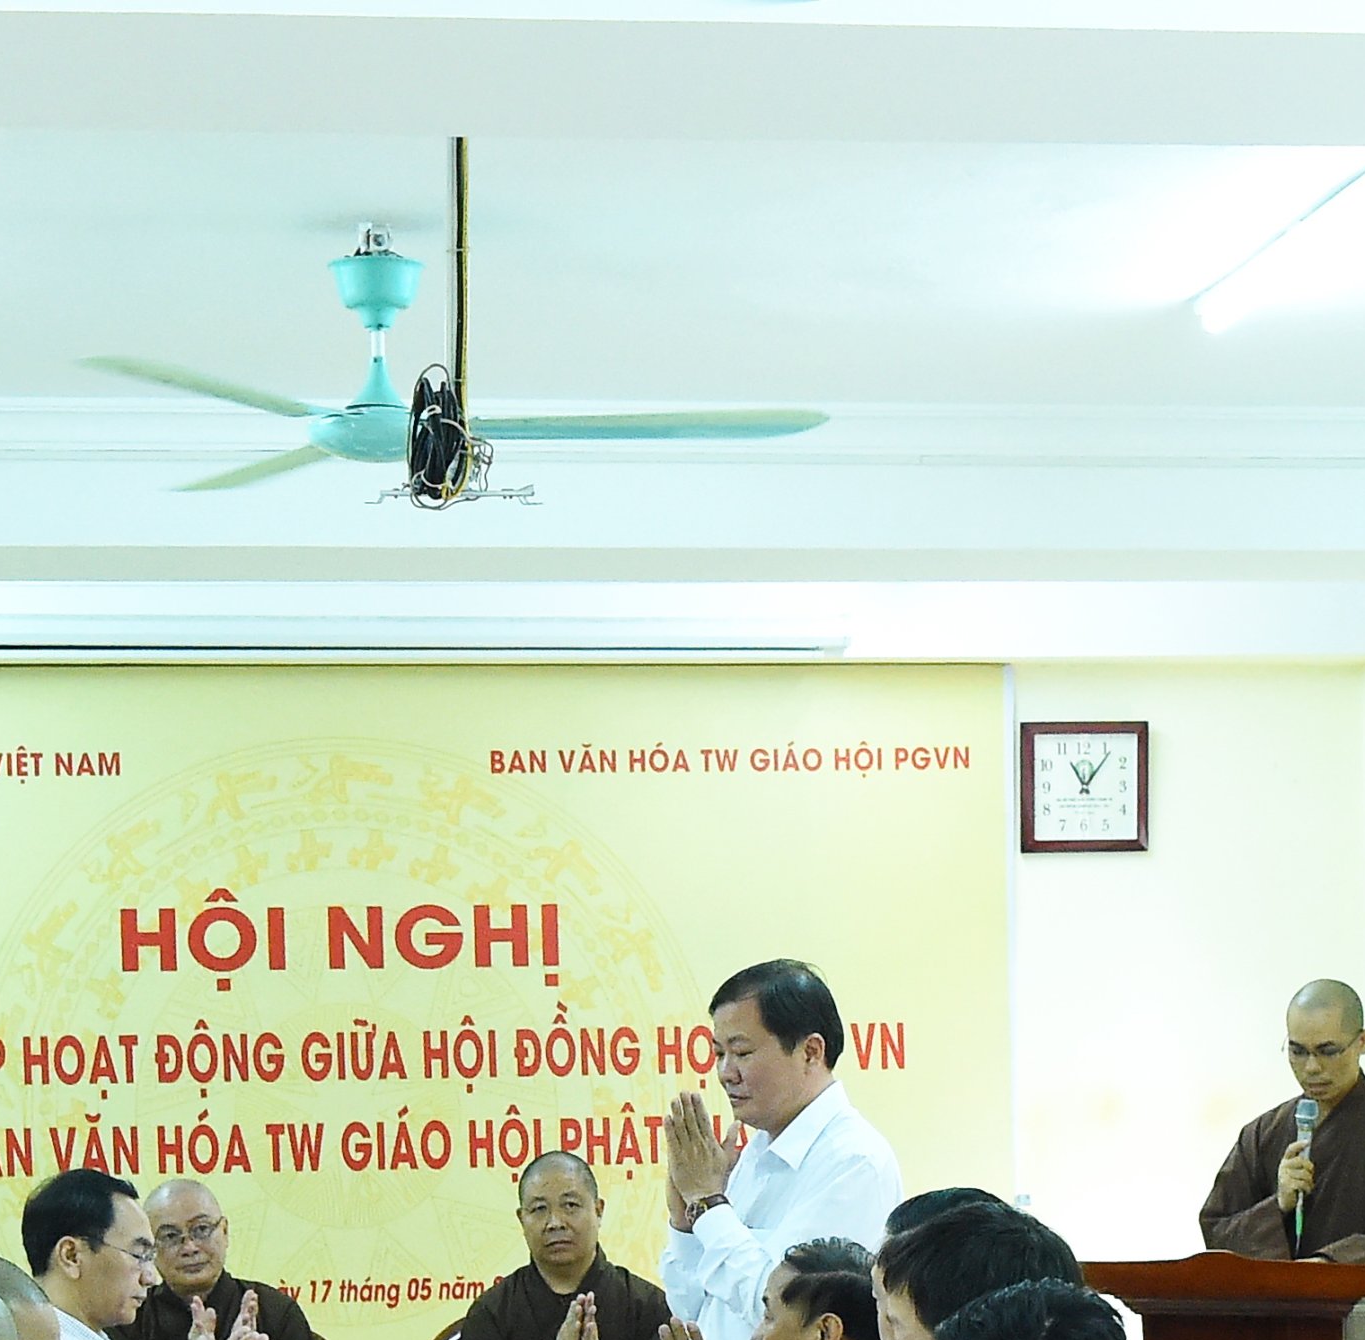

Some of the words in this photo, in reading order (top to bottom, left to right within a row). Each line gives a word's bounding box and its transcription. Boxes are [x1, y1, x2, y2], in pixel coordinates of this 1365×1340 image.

[54, 752, 121, 776] NAM
[489, 750, 548, 774] BAN
[558, 744, 618, 773] VĂN
[628, 742, 691, 773] HÓA
[701, 748, 739, 772] TW
[749, 742, 823, 772] GIÁO
[833, 741, 883, 778] HỘI
[894, 747, 971, 771] PGVN
[119, 887, 287, 992] HỘI
[327, 903, 560, 987] NGHỊ
[22, 1034, 138, 1099] HOẠT
[155, 1019, 285, 1098] ĐỘNG
[301, 1018, 407, 1082] GIỮA
[423, 1015, 498, 1093] HỘI
[514, 1002, 641, 1077] ĐỒNG
[657, 1026, 716, 1089] HỌ
[850, 1023, 906, 1070] VN
[48, 1113, 140, 1175] VĂN
[157, 1109, 252, 1175] HÓA
[265, 1123, 324, 1172] TW
[341, 1105, 453, 1171] GIÁO
[468, 1104, 542, 1183] HỘI
[560, 1102, 664, 1180] PHẬT
[310, 1279, 333, 1303] 17
[339, 1276, 400, 1309] tháng
[406, 1277, 432, 1301] 05
[438, 1275, 485, 1300] năm
